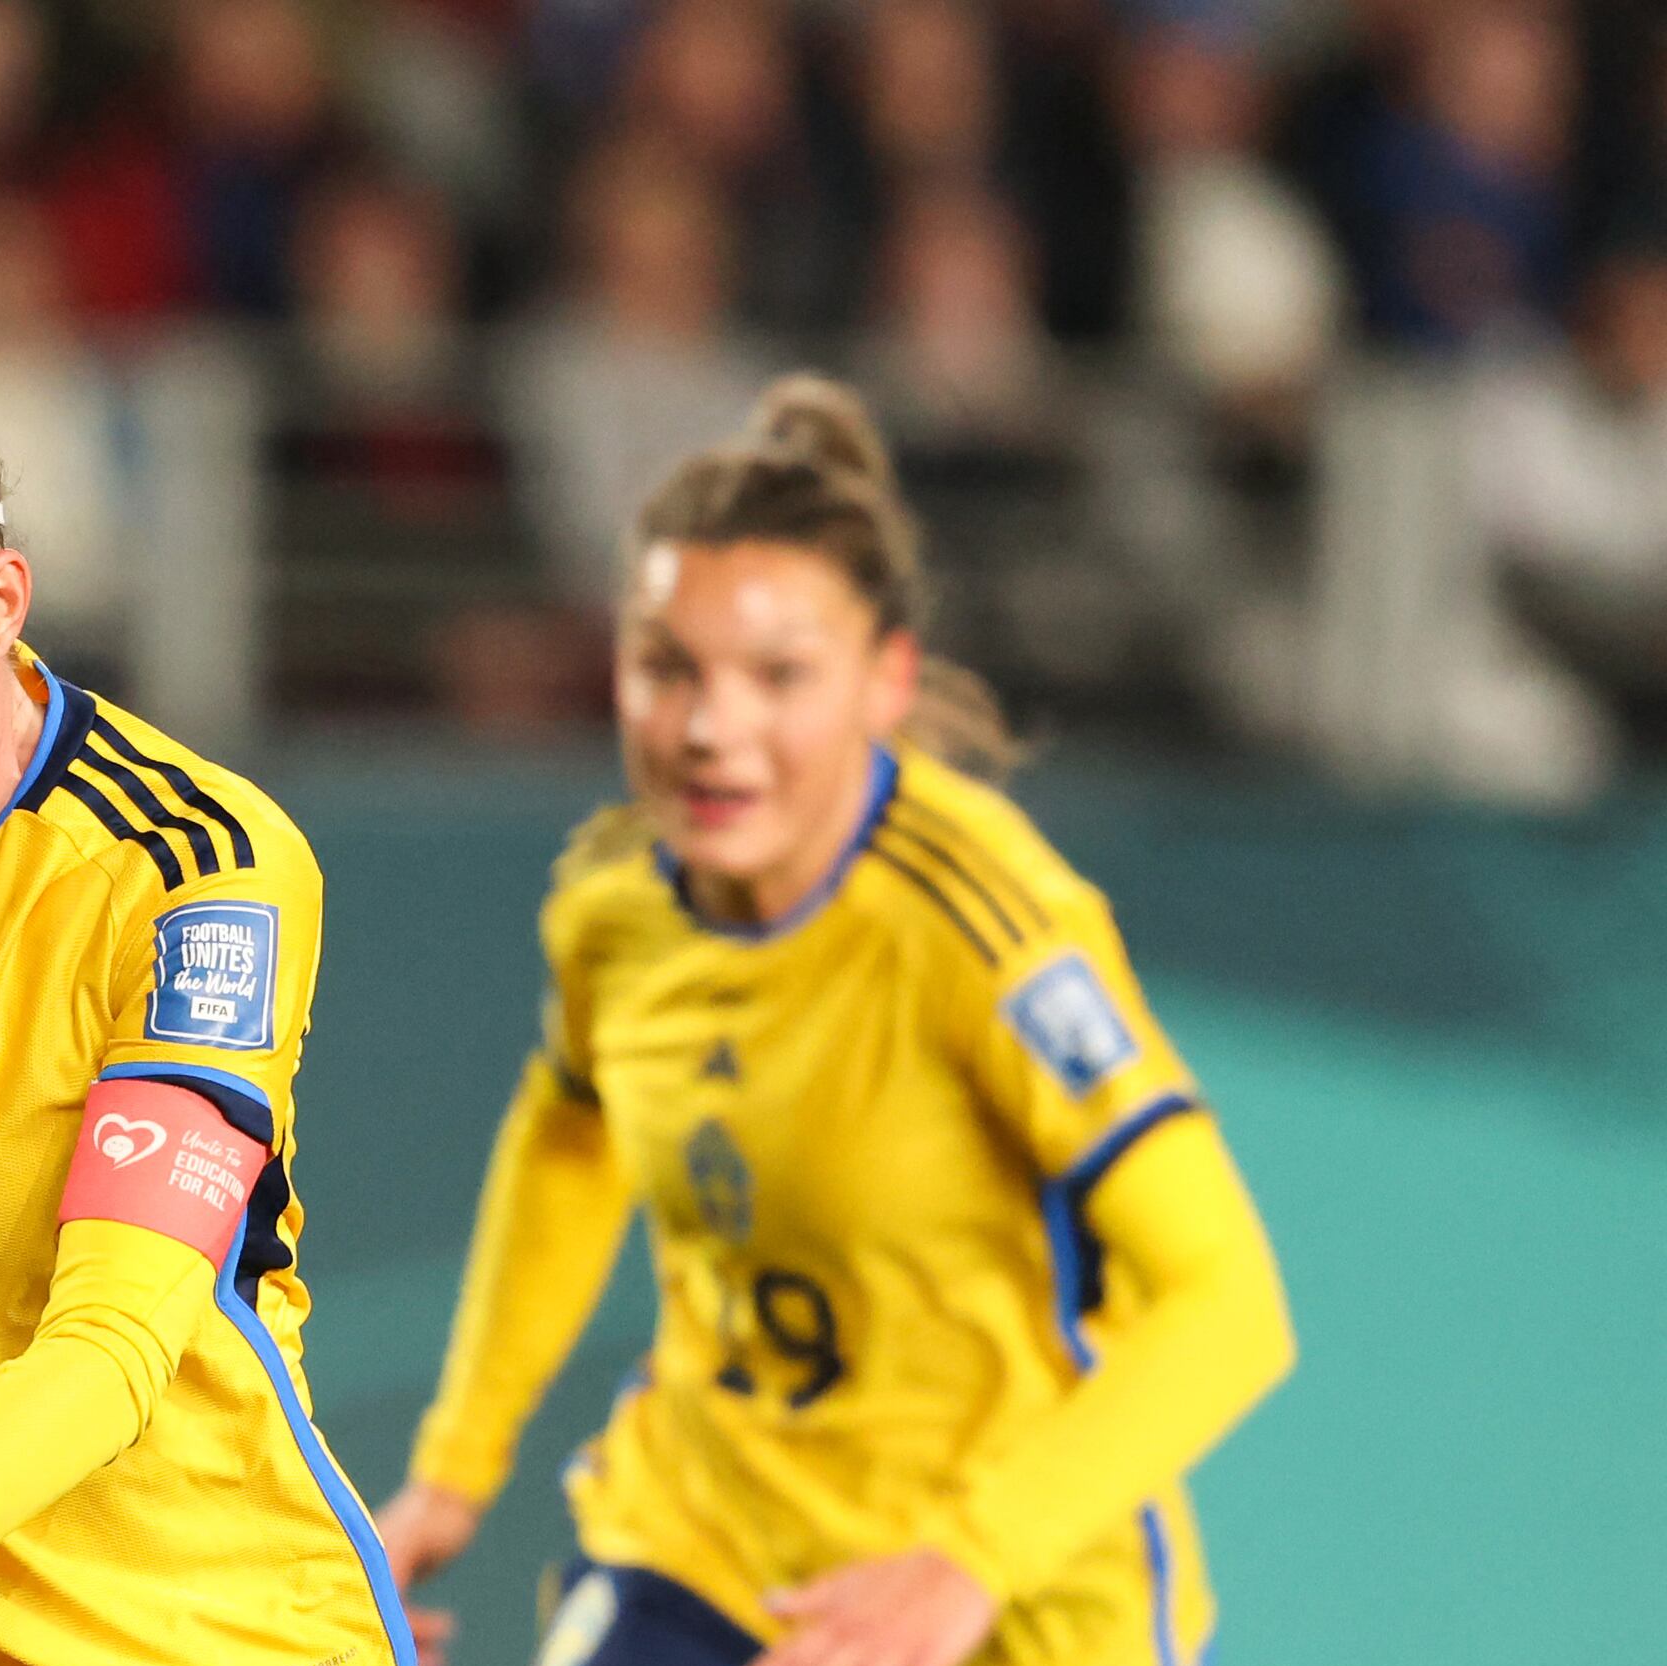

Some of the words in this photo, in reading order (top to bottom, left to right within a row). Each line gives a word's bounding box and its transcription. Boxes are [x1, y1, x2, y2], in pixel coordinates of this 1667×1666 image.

[182, 923, 255, 946] FOOTBALL
[181, 942, 255, 975] UNITES
[174, 967, 203, 991] the
[205, 969, 257, 1001] World
[198, 1003, 229, 1017] FIFA
[168, 1170, 202, 1197] FOR
[203, 1186, 227, 1212] ALL
[174, 1150, 246, 1204] EDUCATION
